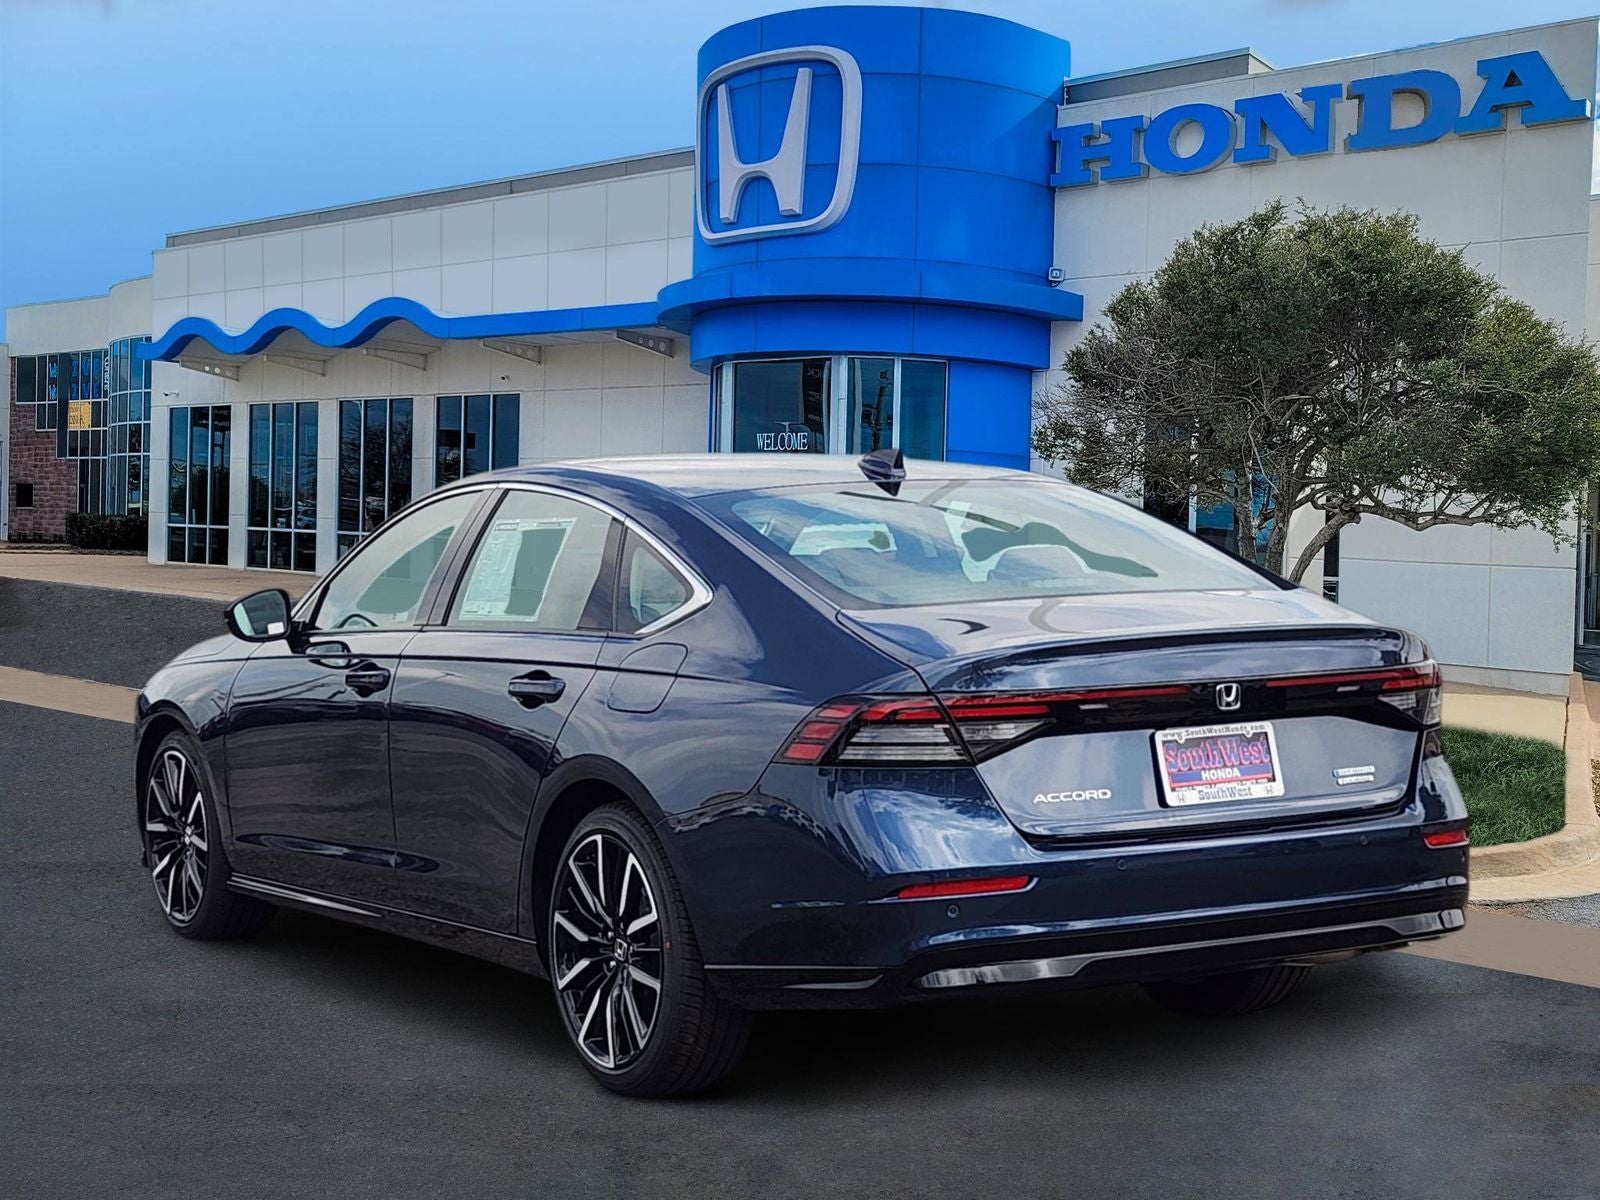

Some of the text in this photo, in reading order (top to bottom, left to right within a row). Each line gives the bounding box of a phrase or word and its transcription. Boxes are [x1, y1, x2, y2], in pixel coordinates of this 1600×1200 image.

[1051, 50, 1591, 188] HONDA
[756, 432, 808, 450] WELCOME
[1163, 736, 1271, 772] SouthWest
[1201, 768, 1241, 780] HONDA
[1032, 788, 1112, 804] ACCORD
[1198, 786, 1252, 801] SouthWest
